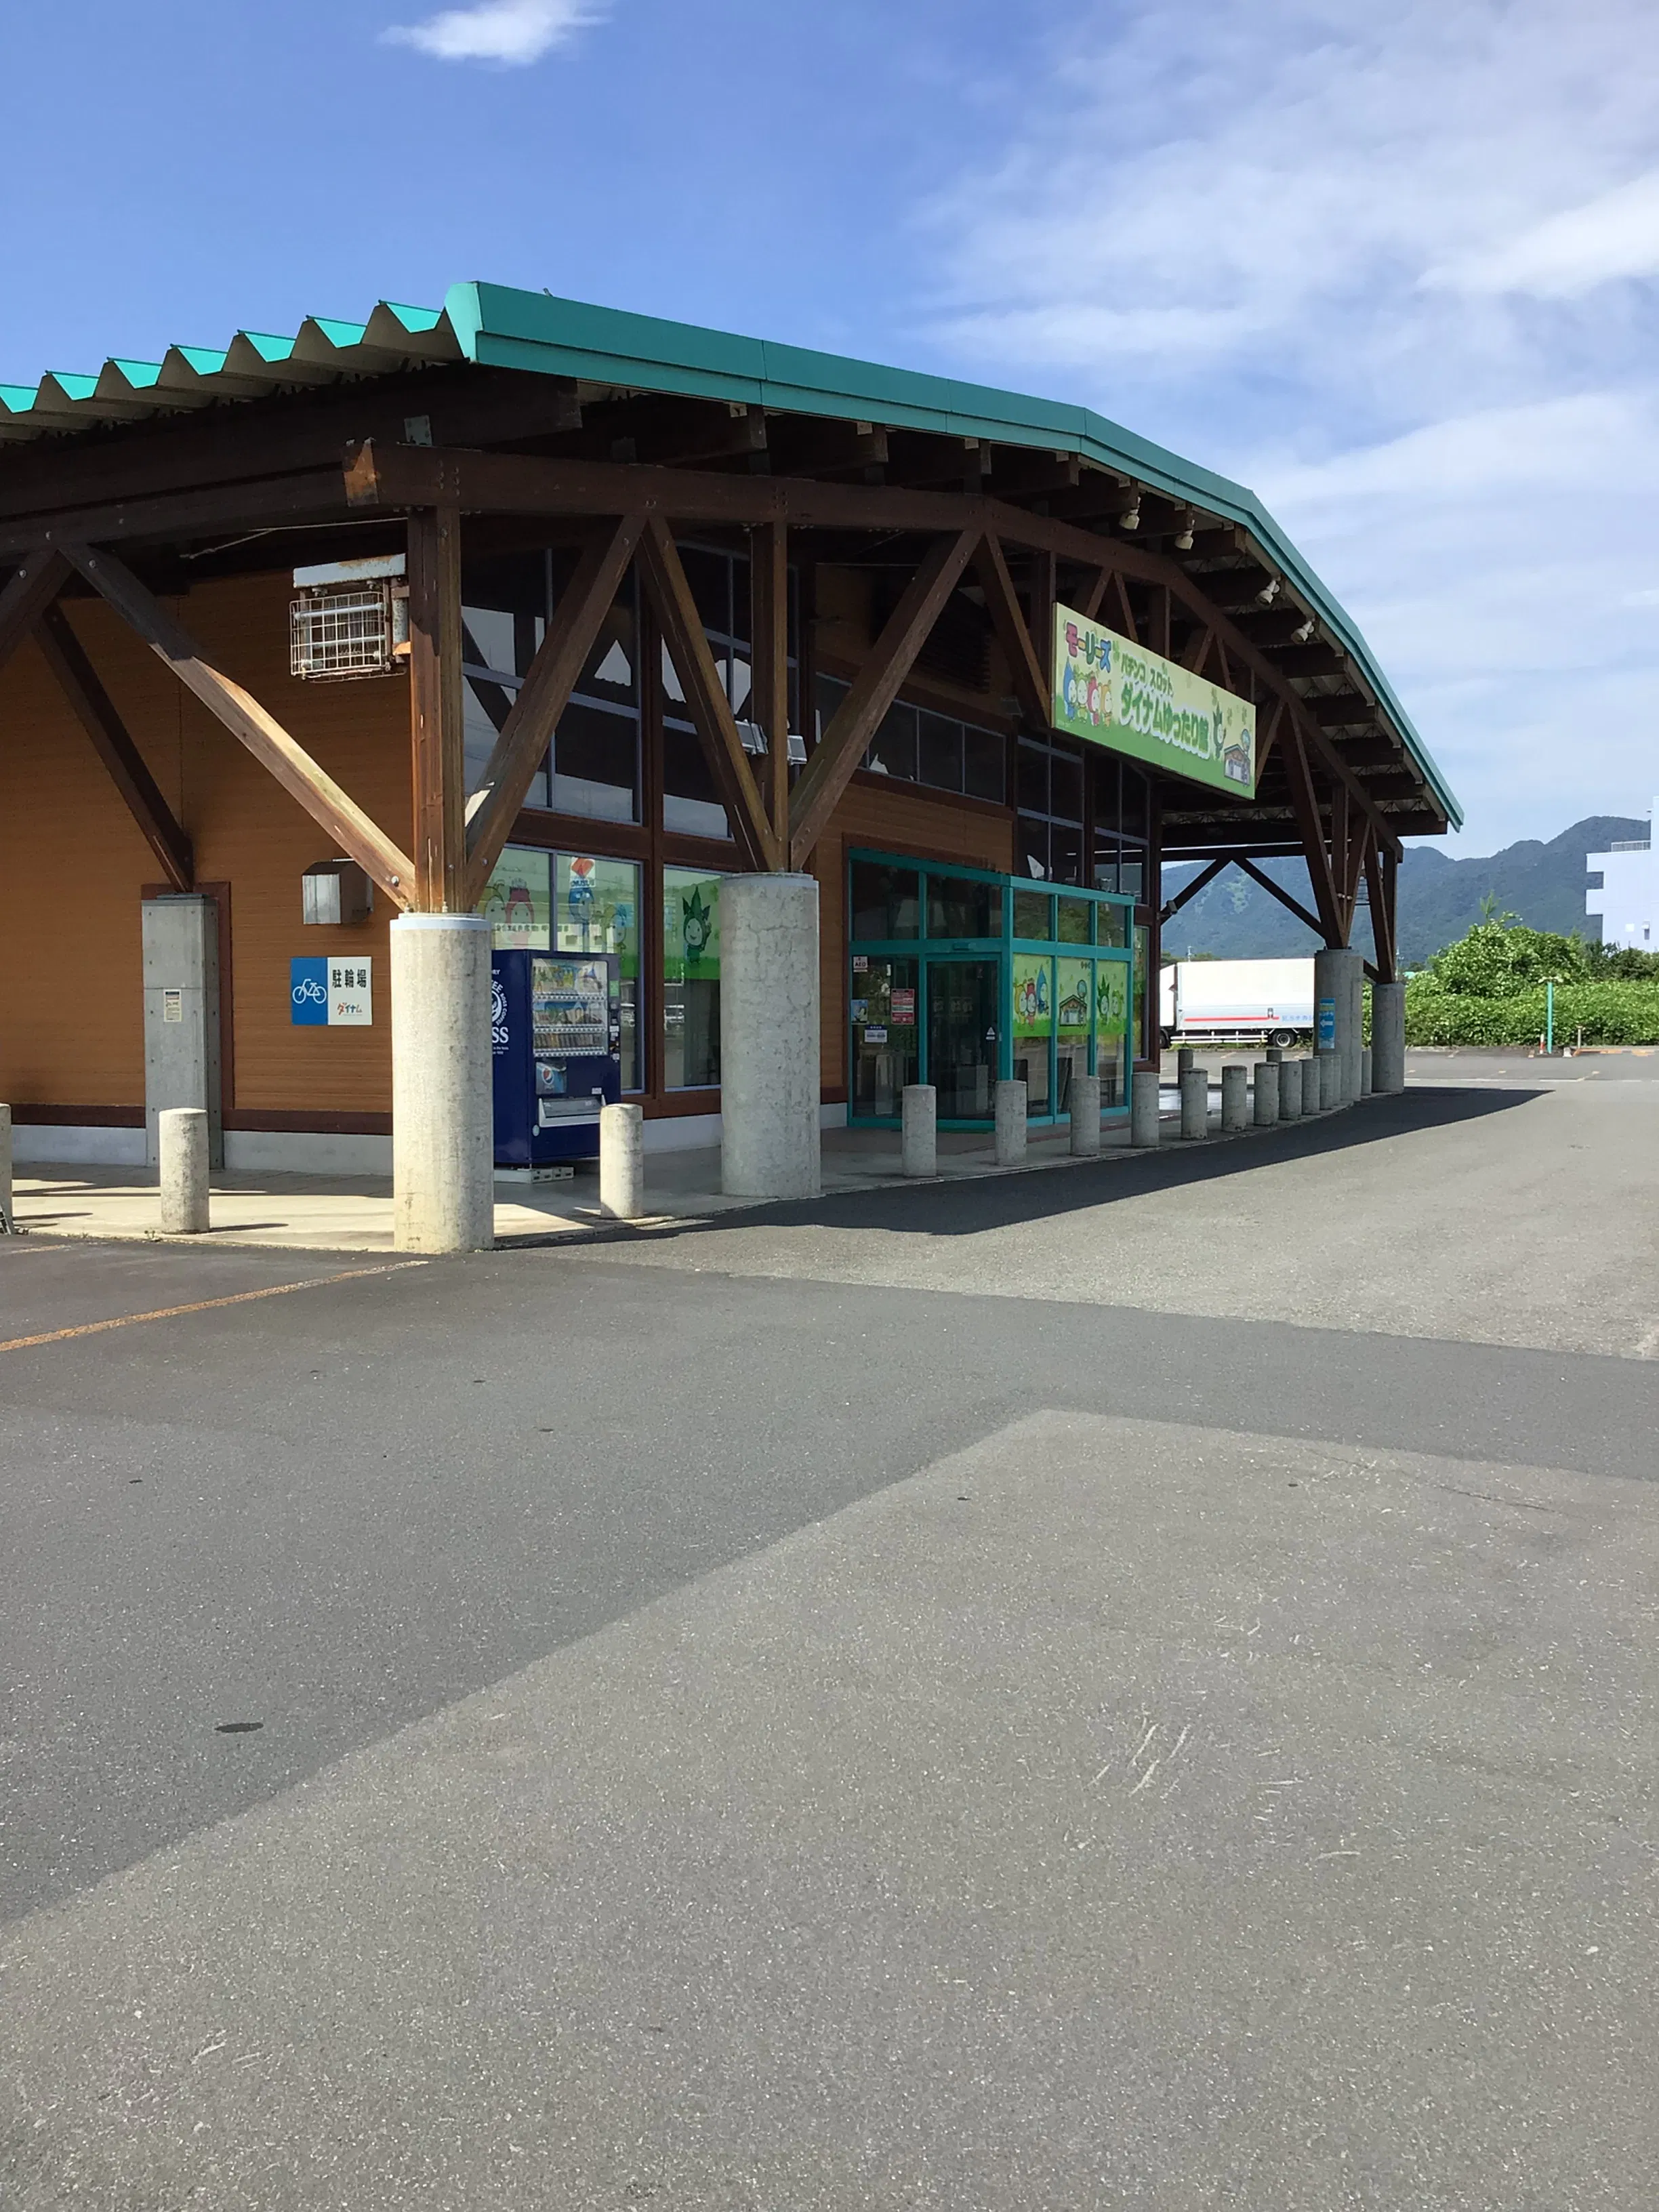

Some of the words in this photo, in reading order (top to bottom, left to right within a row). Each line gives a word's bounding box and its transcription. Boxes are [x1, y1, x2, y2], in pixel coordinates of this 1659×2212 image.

[1122, 653, 1146, 683] パチンコ
[1150, 668, 1174, 697] スロット
[332, 969, 367, 988] 駐輪場
[337, 1002, 363, 1016] ダイナム
